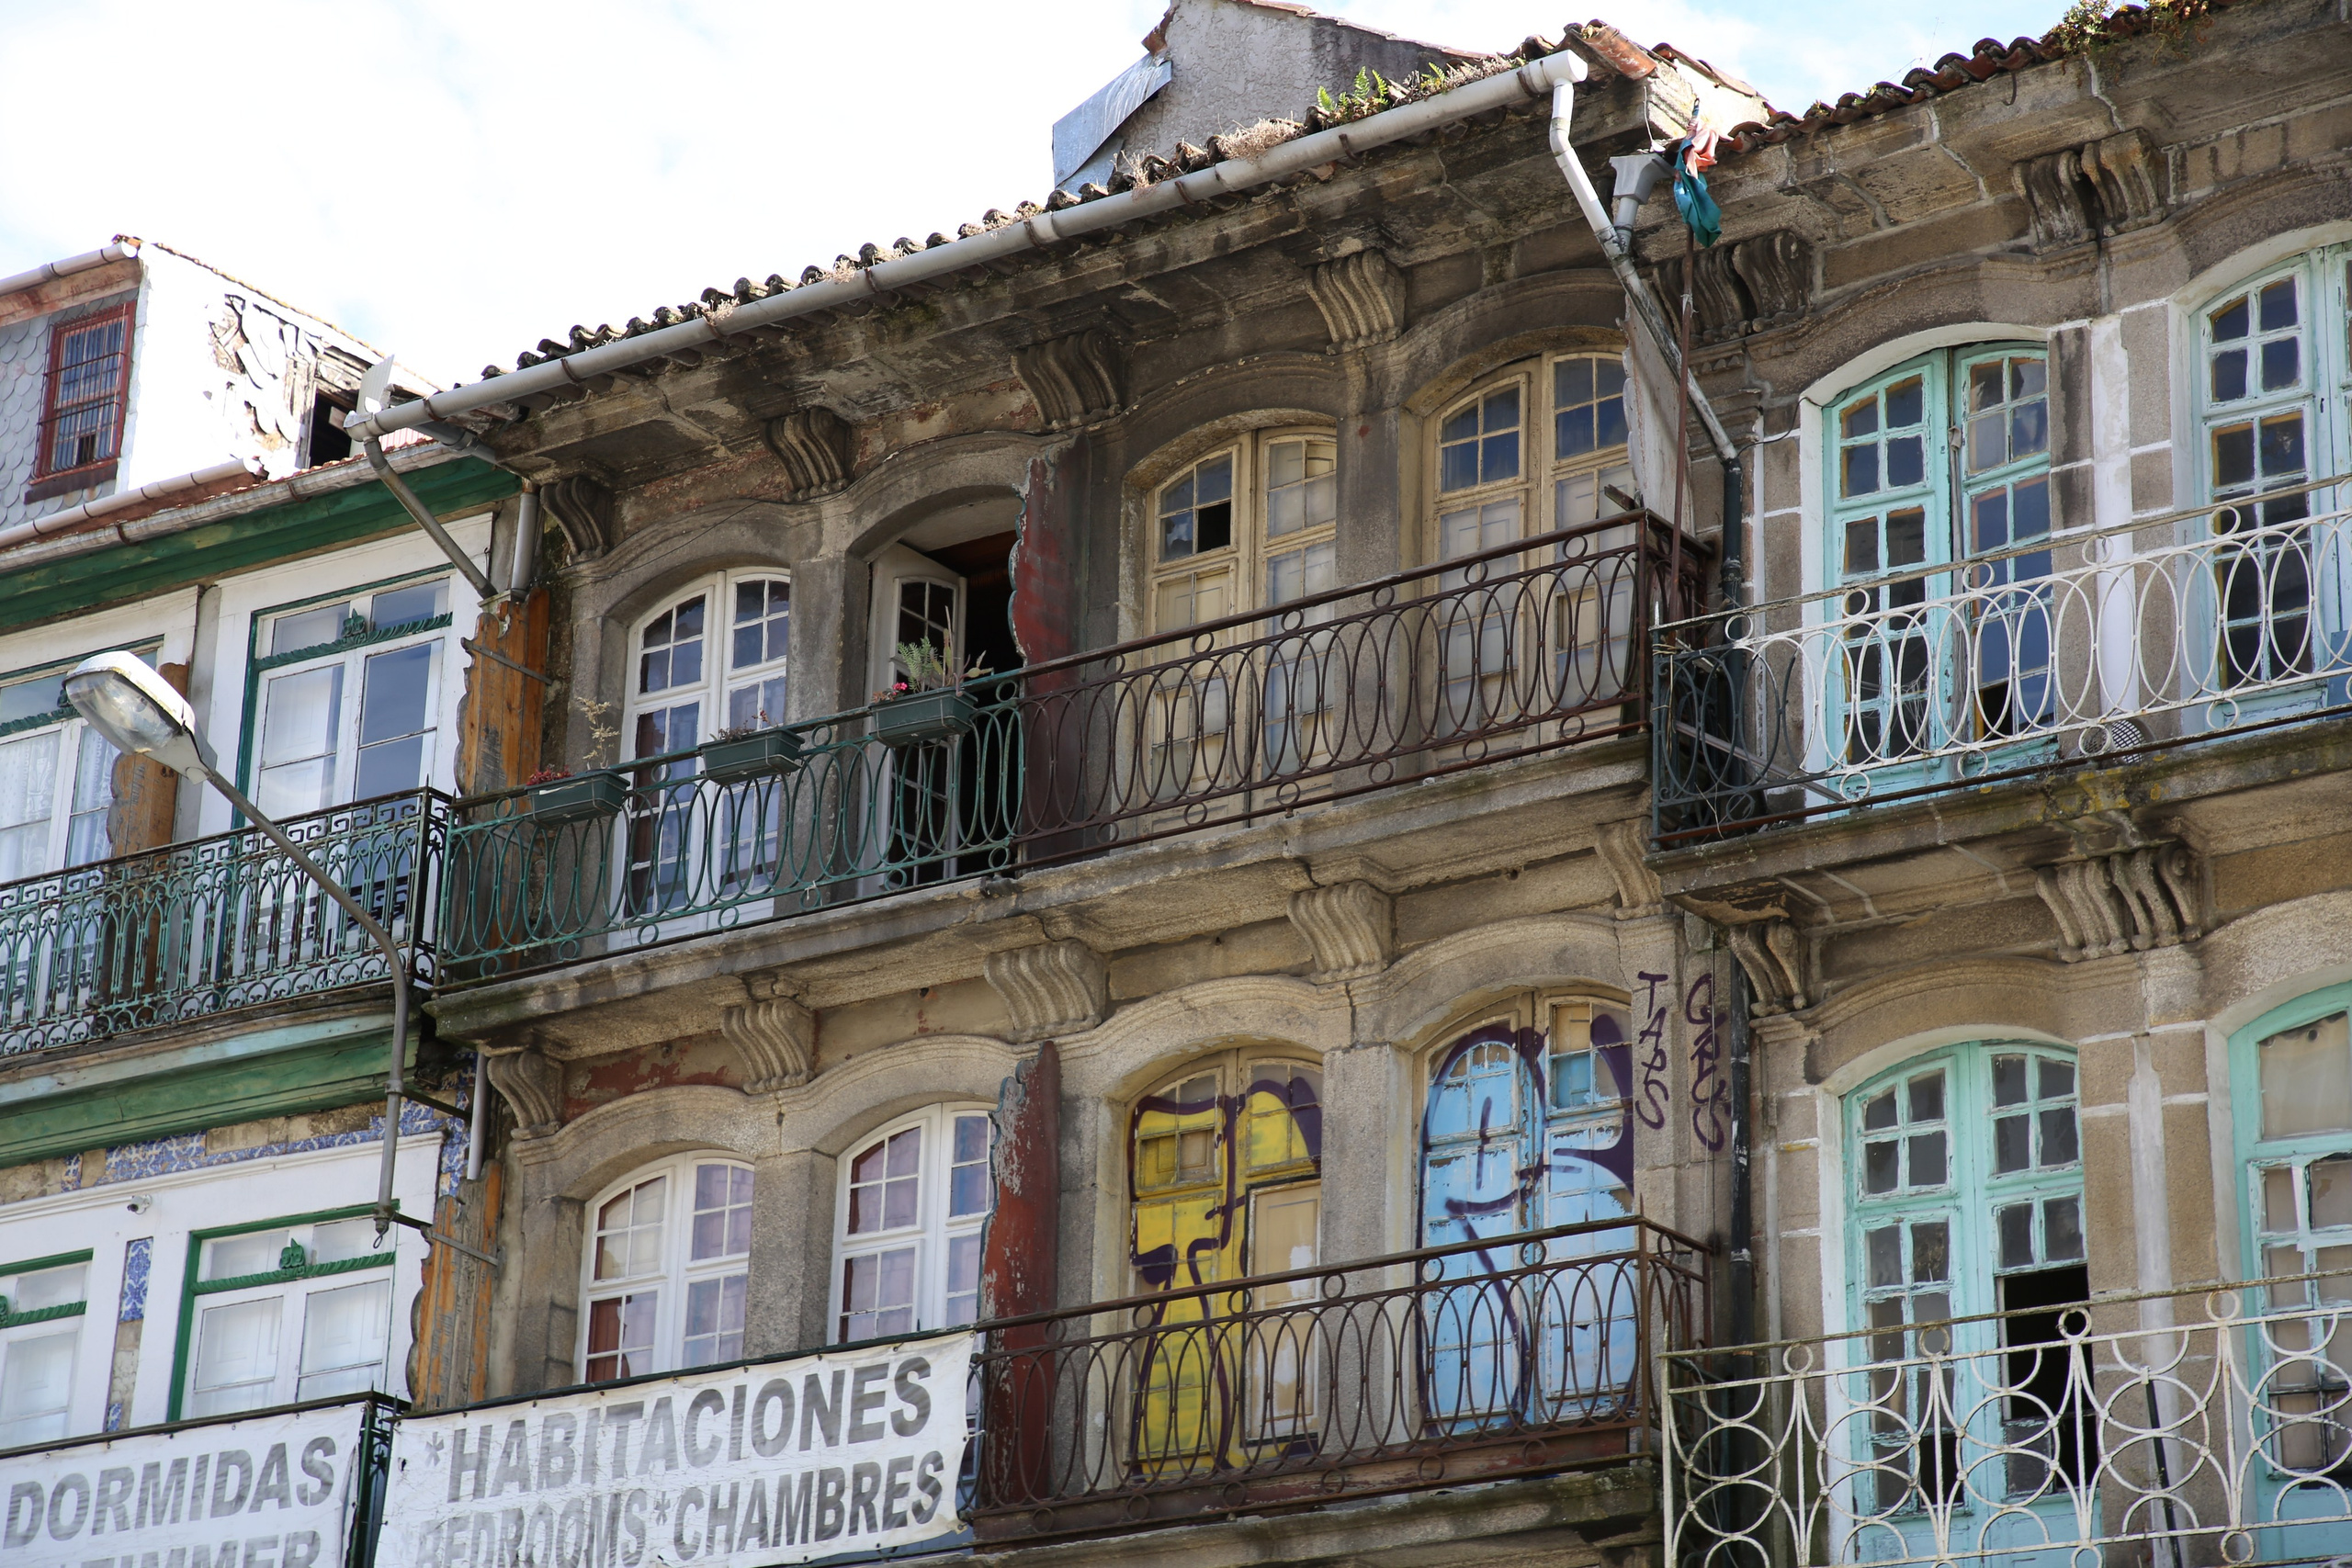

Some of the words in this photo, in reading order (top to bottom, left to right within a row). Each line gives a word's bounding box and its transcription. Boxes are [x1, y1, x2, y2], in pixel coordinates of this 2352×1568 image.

[447, 1356, 933, 1504] HABITACIONES
[2, 1436, 337, 1551] DORMIDAS
[673, 1450, 945, 1562] CHAMBRES
